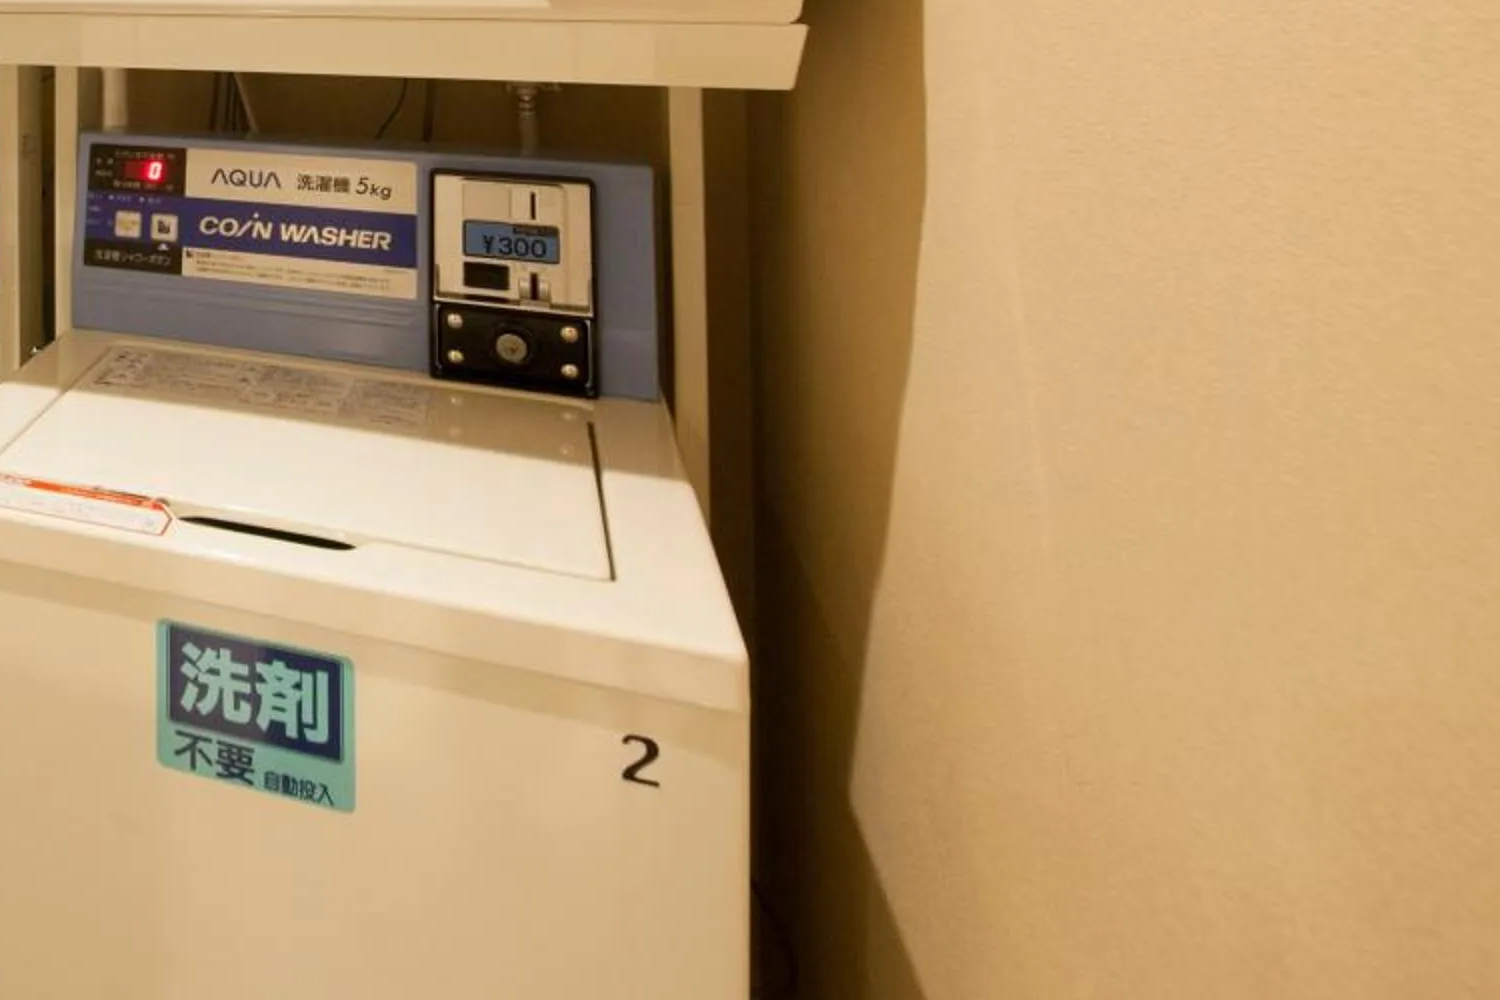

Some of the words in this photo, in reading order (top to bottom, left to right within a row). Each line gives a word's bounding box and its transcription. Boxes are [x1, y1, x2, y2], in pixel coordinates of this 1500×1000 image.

[148, 161, 162, 181] 0
[211, 168, 281, 190] AQUA
[297, 173, 351, 194] 洗濯機
[355, 177, 392, 201] 5kg
[280, 224, 392, 250] WASHER
[180, 641, 329, 745] 洗剤
[174, 729, 256, 787] 不要
[263, 770, 335, 807] 自動投入
[621, 734, 660, 789] 2
